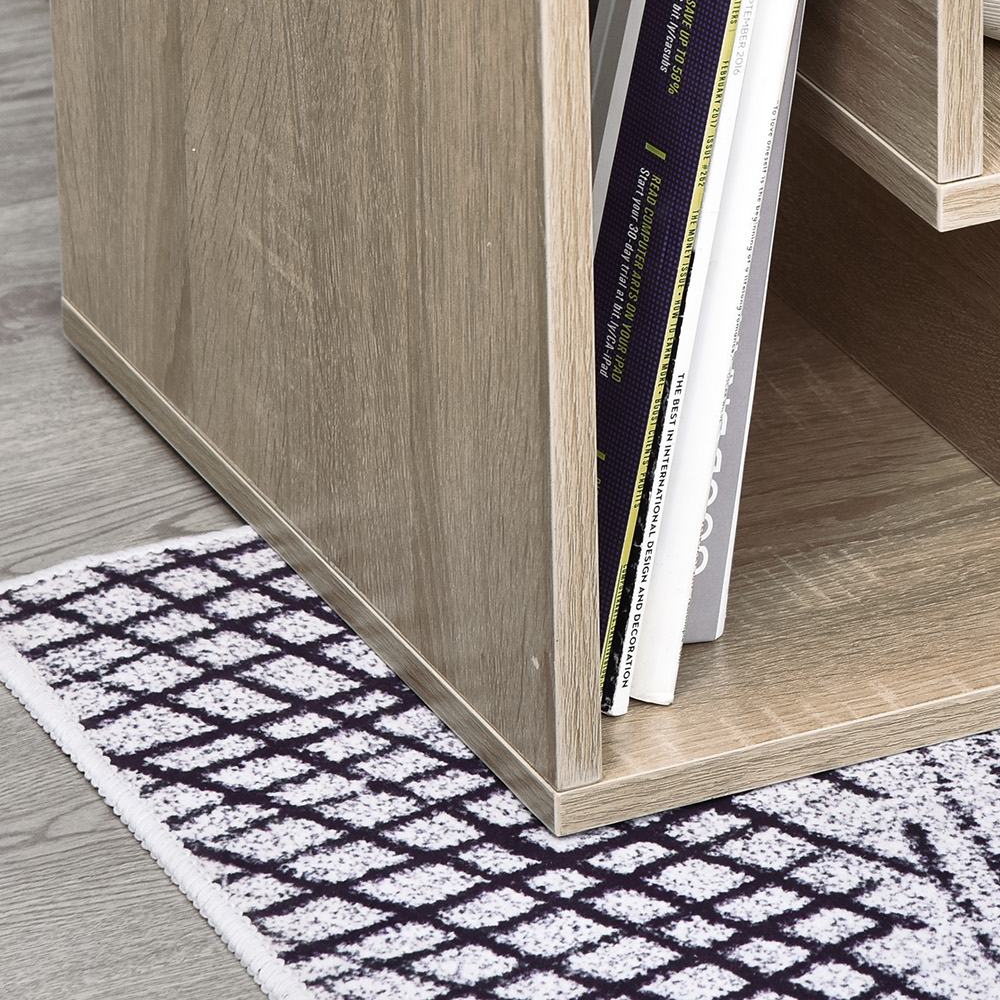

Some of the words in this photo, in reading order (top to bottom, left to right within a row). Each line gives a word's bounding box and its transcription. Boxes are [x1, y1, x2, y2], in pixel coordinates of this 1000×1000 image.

[677, 28, 689, 47] UP
[674, 47, 685, 65] TO
[734, 52, 744, 76] 2016
[668, 65, 682, 96] 58%
[716, 61, 729, 104] FEBRUARY
[711, 108, 720, 129] 2017
[704, 135, 714, 161] ISSUE
[635, 166, 649, 196] Start
[646, 173, 661, 205] READ
[629, 197, 643, 222] your
[690, 208, 698, 225] THE
[621, 221, 638, 262] 30-day
[634, 205, 654, 270] COMPUTER
[683, 227, 695, 259] MONEY
[617, 262, 630, 288] trial
[627, 269, 642, 301] ARTS
[677, 261, 688, 289] ISSUE
[615, 287, 625, 301] at
[623, 301, 635, 321] ON
[617, 320, 631, 354] YOUR
[674, 371, 685, 396] THE
[668, 397, 681, 426] BEST
[666, 430, 674, 442] IN
[648, 444, 672, 538] INTERNATIONAL
[640, 541, 654, 582] DESIGN
[635, 587, 645, 610] AND
[621, 614, 640, 689] DECORATION
